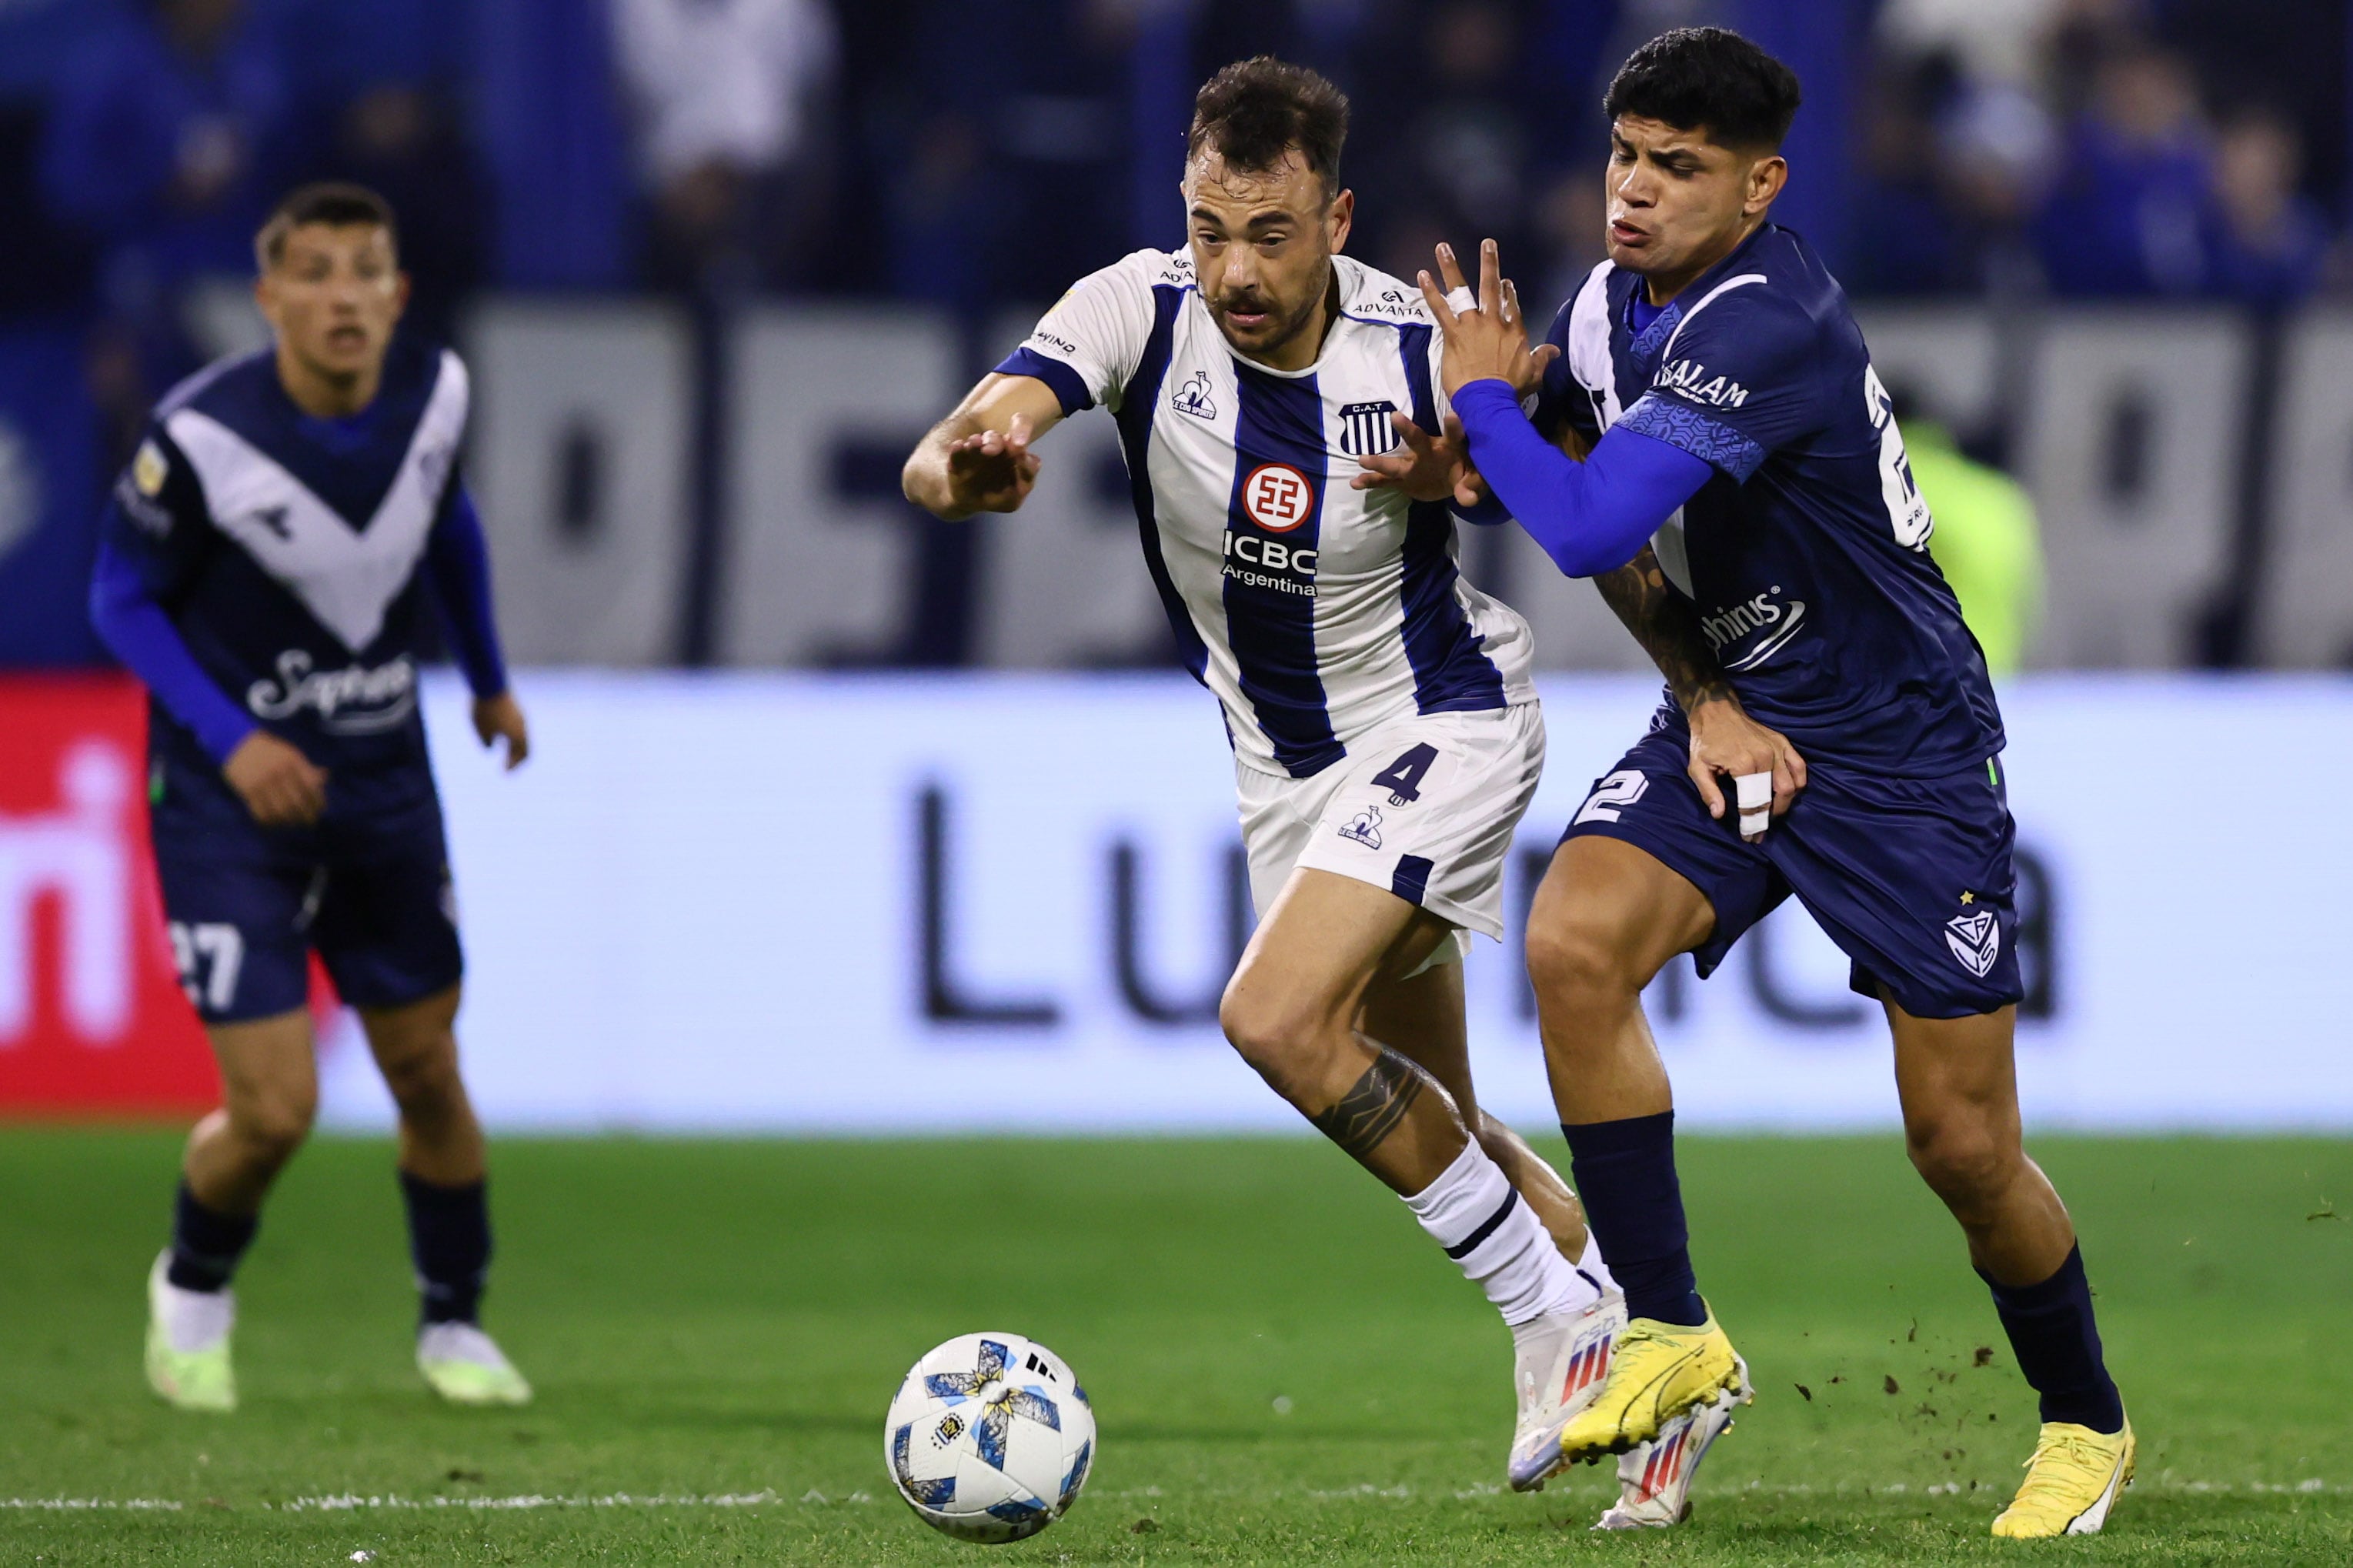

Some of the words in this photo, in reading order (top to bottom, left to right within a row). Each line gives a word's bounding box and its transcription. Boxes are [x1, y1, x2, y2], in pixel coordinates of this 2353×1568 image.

[1353, 303, 1424, 318] ADVANTA
[1191, 406, 1215, 419] SPORTIF
[1223, 529, 1318, 575] ICBC
[1221, 563, 1317, 597] Argentina
[1370, 742, 1439, 802] 4
[1574, 769, 1650, 826] 2
